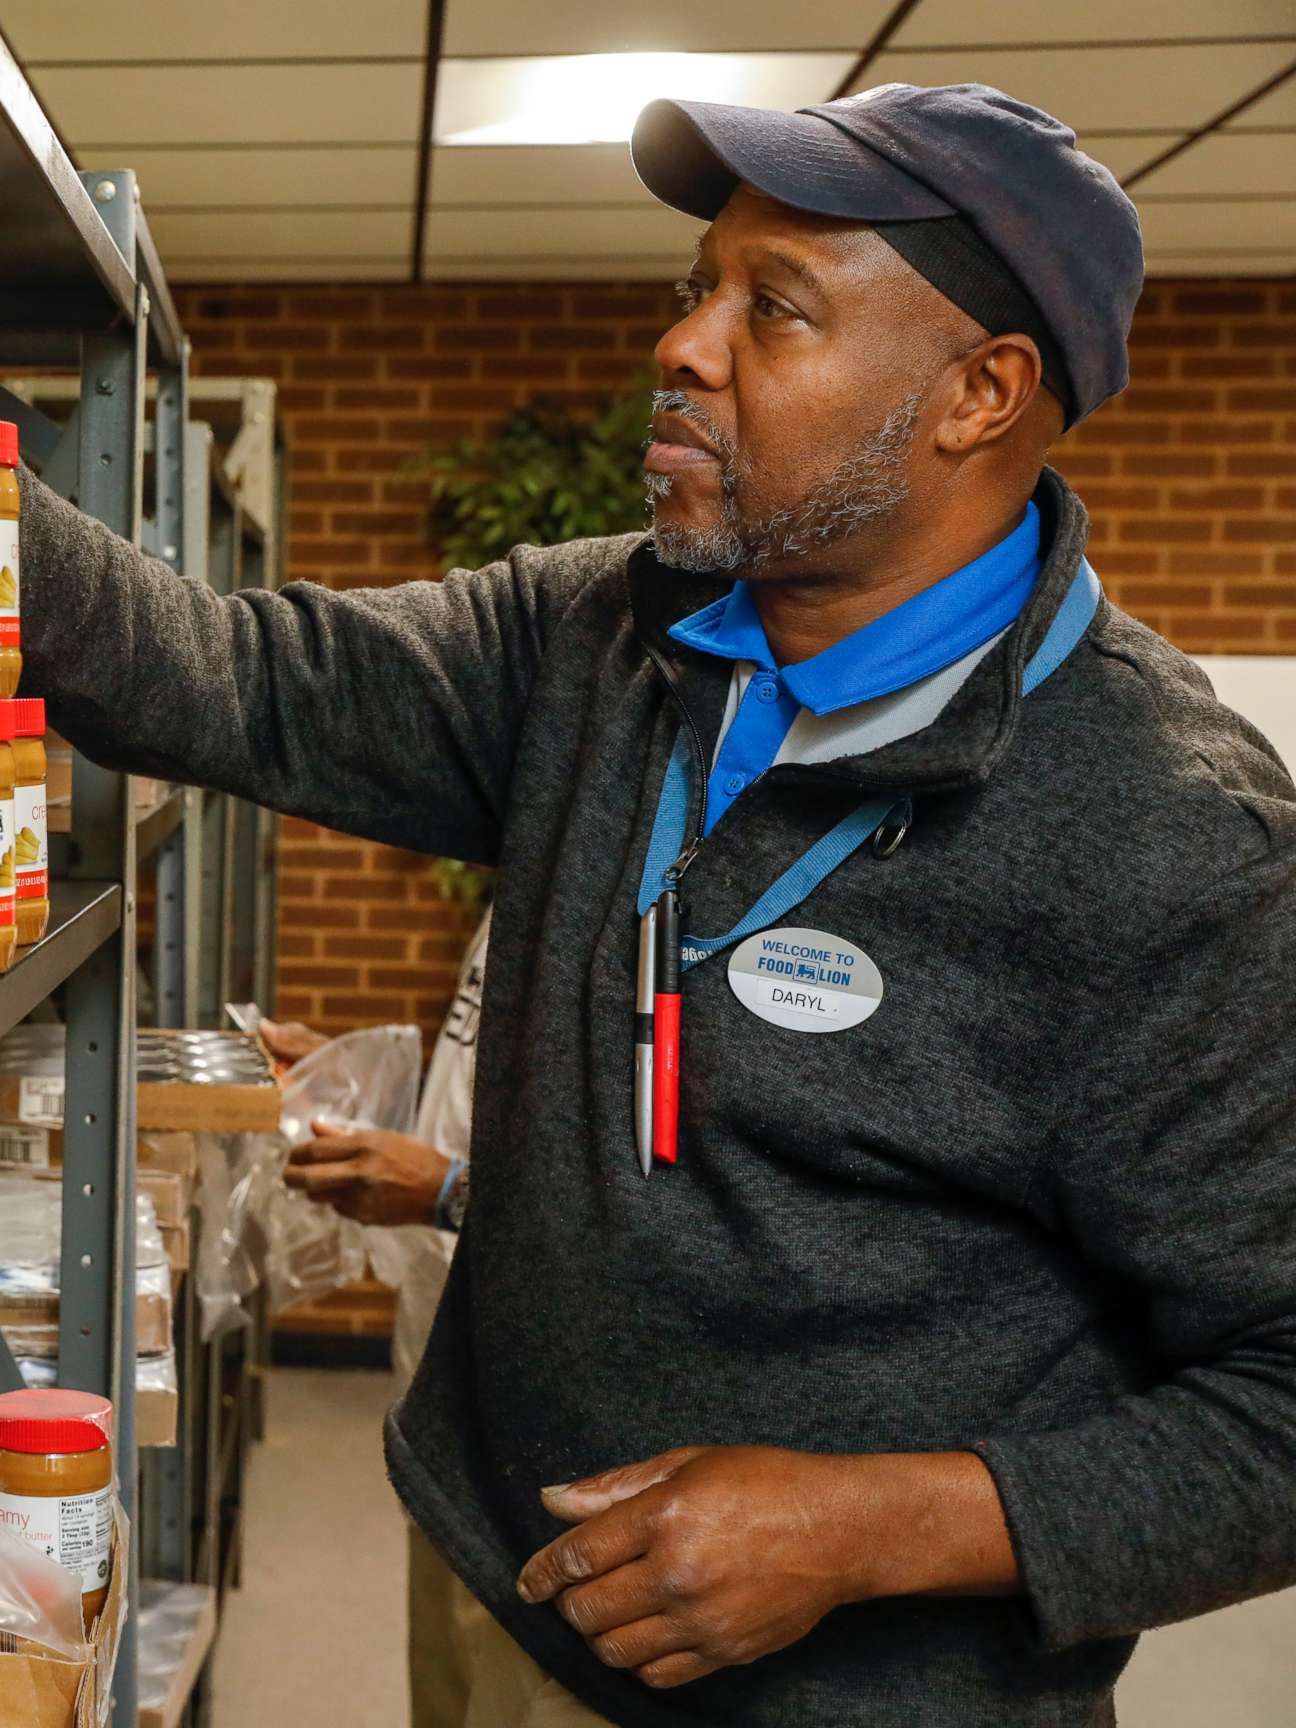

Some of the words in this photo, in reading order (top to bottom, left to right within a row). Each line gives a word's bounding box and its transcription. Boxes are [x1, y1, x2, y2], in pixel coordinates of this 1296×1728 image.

[762, 938, 832, 965] WELCOME
[836, 952, 855, 967] TO
[757, 956, 794, 975] FOOD
[819, 971, 852, 987] LION
[771, 988, 826, 1011] DARYL
[61, 1498, 93, 1507] Nutrition
